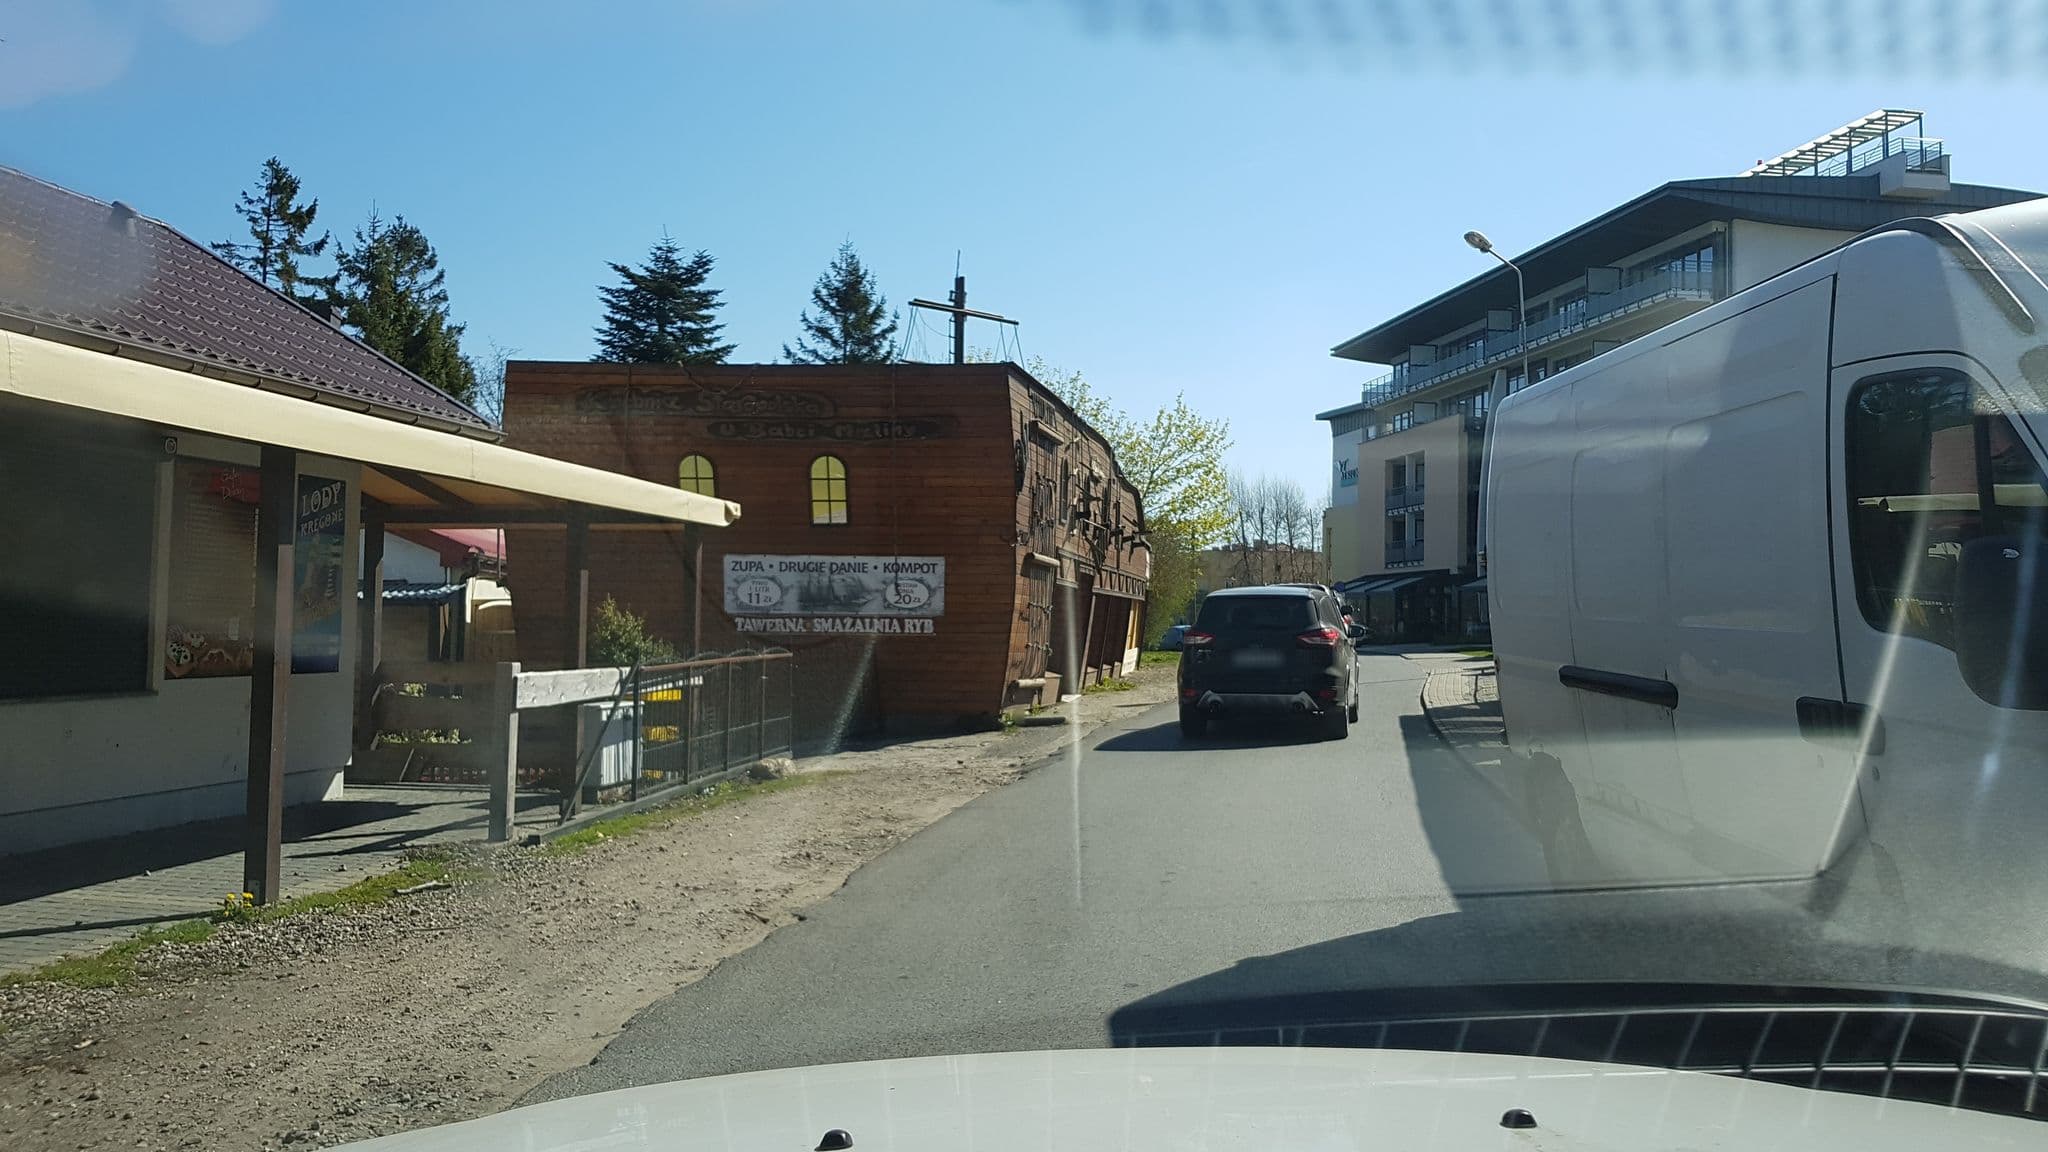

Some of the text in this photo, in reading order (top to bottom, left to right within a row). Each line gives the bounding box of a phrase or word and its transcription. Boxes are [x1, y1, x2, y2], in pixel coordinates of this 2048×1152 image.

[302, 481, 341, 517] LODY
[731, 560, 939, 574] ZUPA DRUGIE DANIE KOMPOT
[747, 592, 761, 604] 11
[894, 594, 912, 605] 20
[734, 616, 934, 633] TAWERNA SMAŻALNIA RYB
